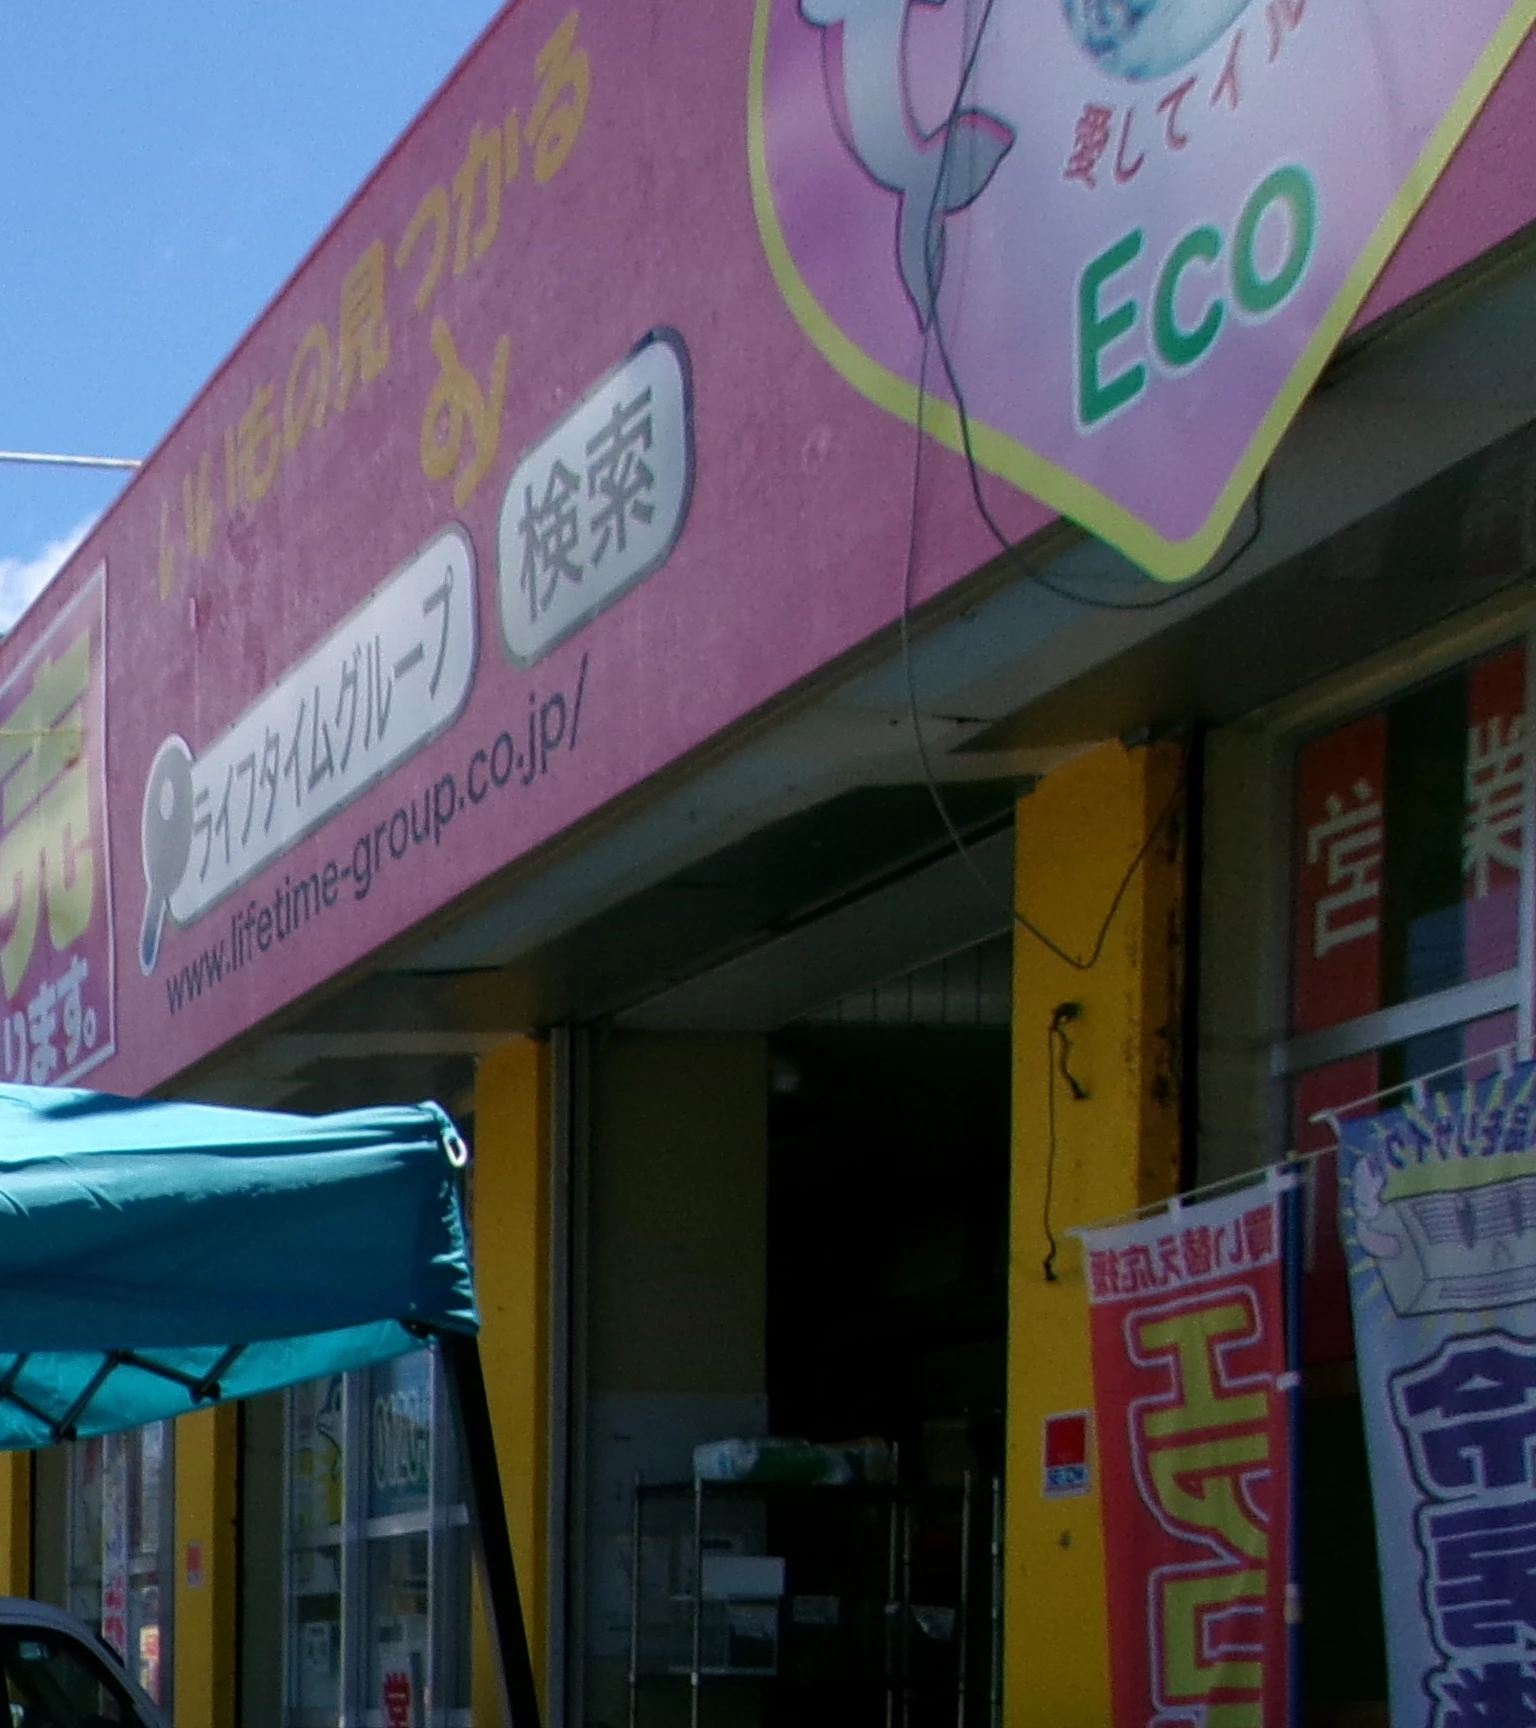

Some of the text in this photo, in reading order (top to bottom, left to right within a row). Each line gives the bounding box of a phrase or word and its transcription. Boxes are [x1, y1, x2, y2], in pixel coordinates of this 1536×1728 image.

[1077, 164, 1317, 426] ECO
[518, 384, 654, 622] 検索
[165, 652, 590, 1017] www.lifetime-group.co.jp/
[191, 564, 456, 880] ライフタイムグループ
